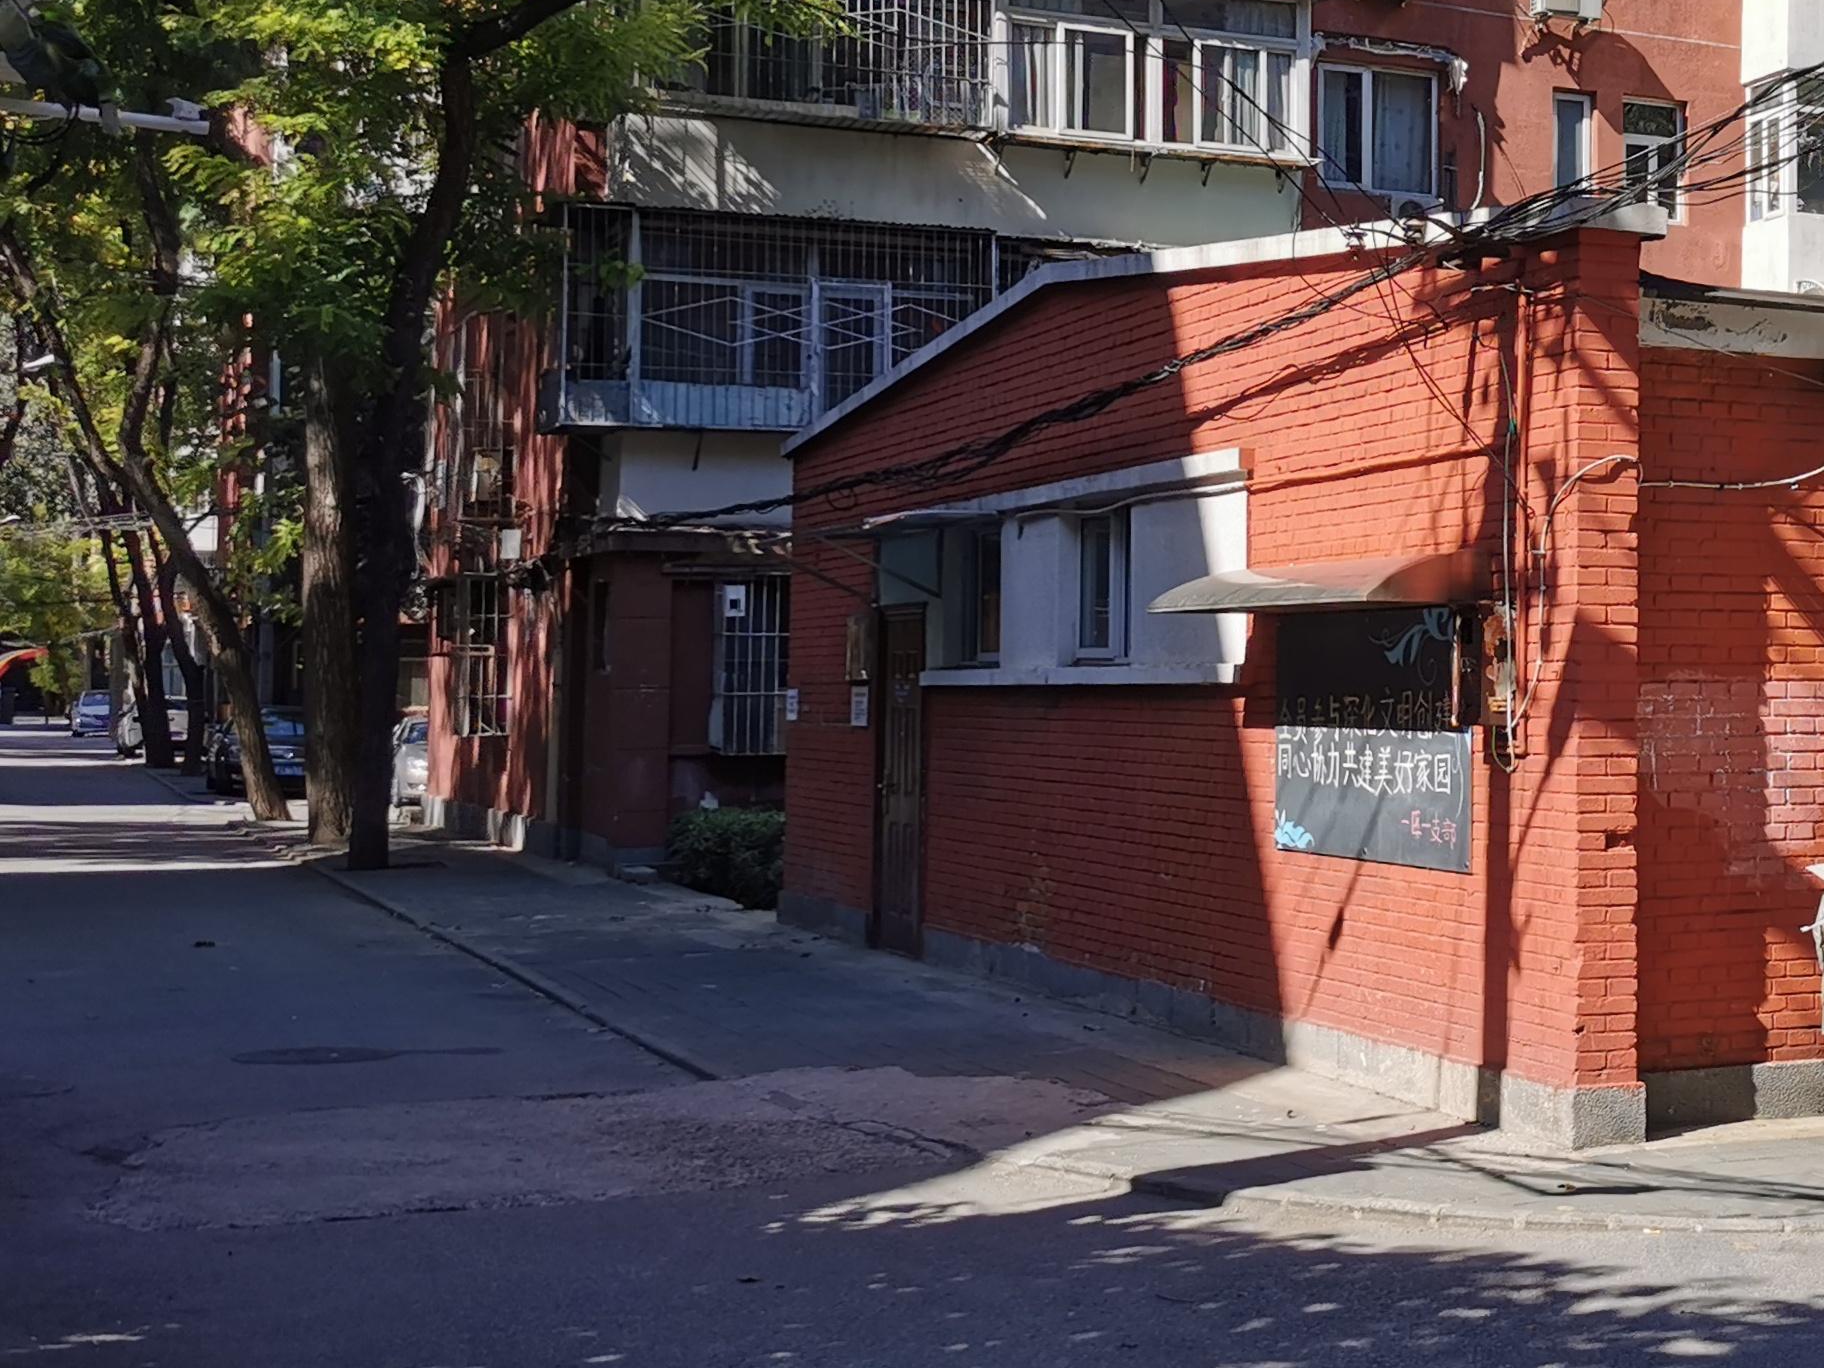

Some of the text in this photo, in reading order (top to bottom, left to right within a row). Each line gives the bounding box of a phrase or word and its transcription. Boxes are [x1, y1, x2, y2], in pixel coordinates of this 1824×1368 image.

[1277, 741, 1452, 797] 同心协力共建美好家园
